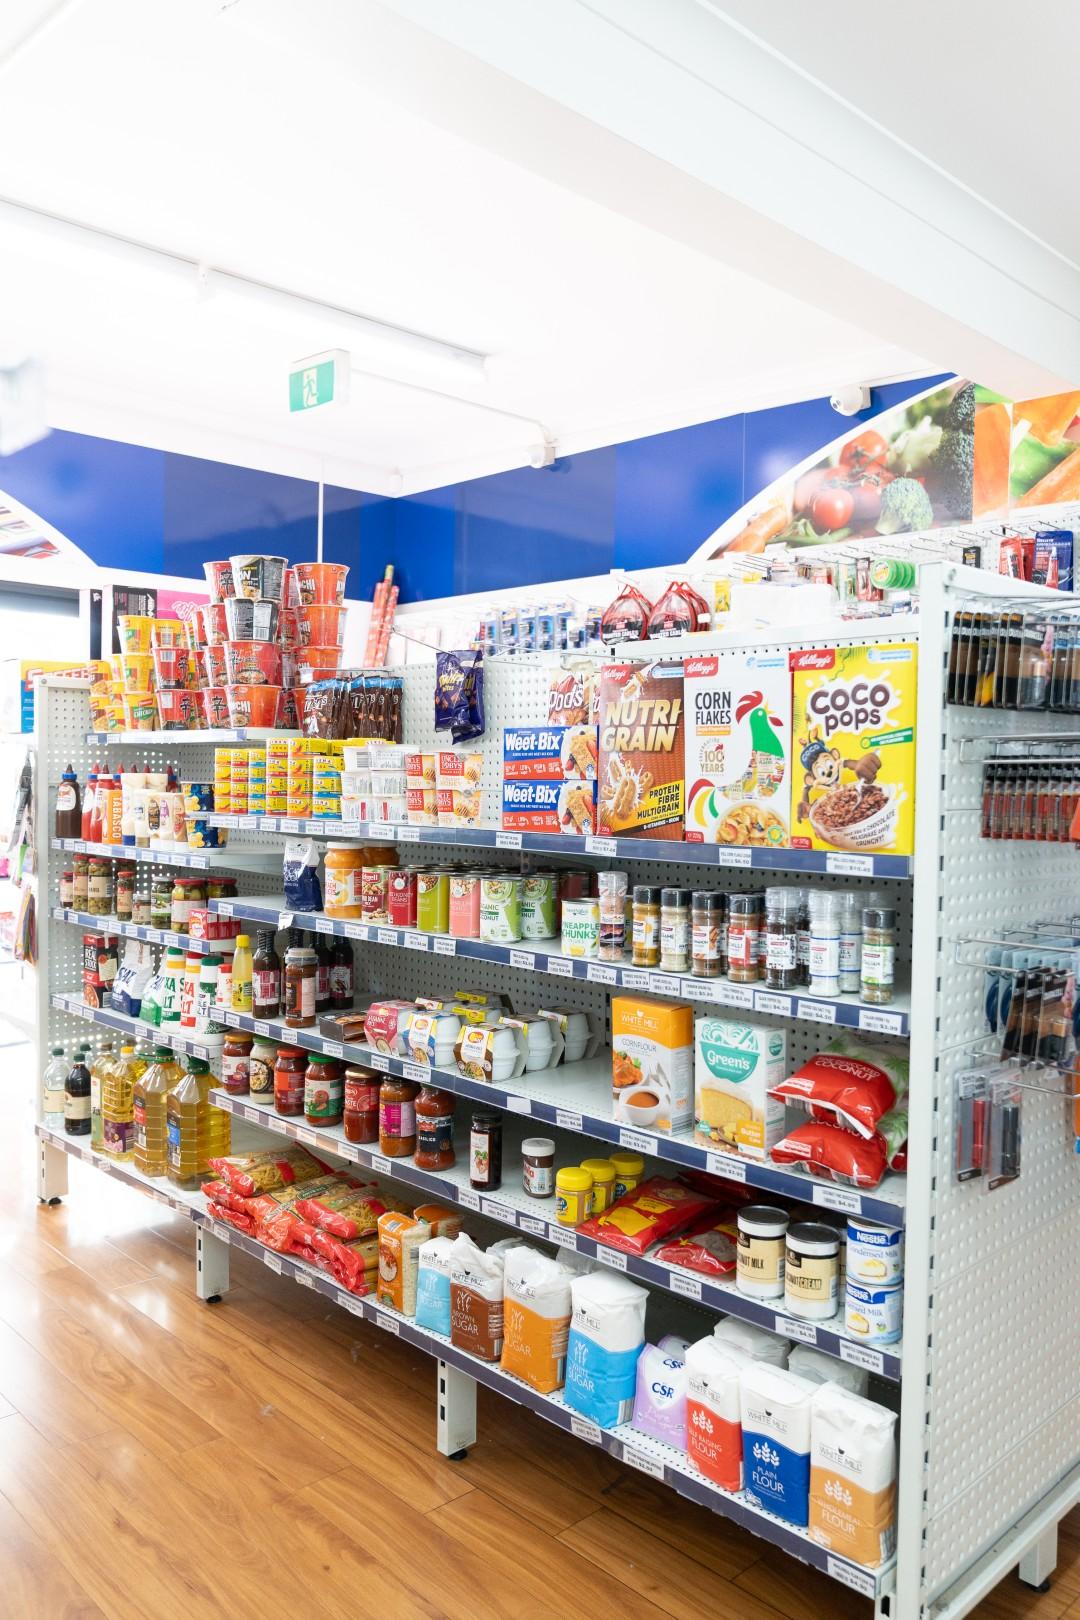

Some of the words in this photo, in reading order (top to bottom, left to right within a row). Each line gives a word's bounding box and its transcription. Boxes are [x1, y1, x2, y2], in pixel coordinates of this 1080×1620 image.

[695, 691, 731, 710] CORN
[811, 683, 890, 714] COCO
[695, 710, 731, 725] FLAKES
[825, 708, 881, 737] pops
[505, 731, 562, 751] Weet-Bix
[602, 726, 677, 753] GRAIN
[704, 750, 724, 763] 100
[700, 763, 724, 774] YEARS
[503, 784, 558, 804] Weet-Bix
[648, 783, 680, 799] PROTEIN
[658, 793, 680, 805] FIBRE
[112, 796, 122, 839] TABASCO
[637, 801, 680, 820] MULTIGRAIN
[621, 1038, 657, 1053] CORNFLOUR
[706, 1049, 750, 1072] Green's
[815, 1061, 875, 1081] COCONUT
[345, 1099, 357, 1107] ASTE
[751, 1256, 764, 1269] MILK
[451, 1315, 479, 1336] SUGAR
[663, 1358, 685, 1369] CSR
[568, 1366, 595, 1393] SUGAR
[652, 1382, 674, 1399] CSR
[747, 1409, 771, 1425] WHITE
[772, 1421, 788, 1432] MILL
[691, 1437, 718, 1462] FLOUR
[819, 1446, 843, 1463] WHITE
[844, 1457, 862, 1472] MILL
[757, 1465, 777, 1480] PLAIN
[752, 1471, 785, 1495] FLOUR
[821, 1510, 856, 1537] FLOUR
